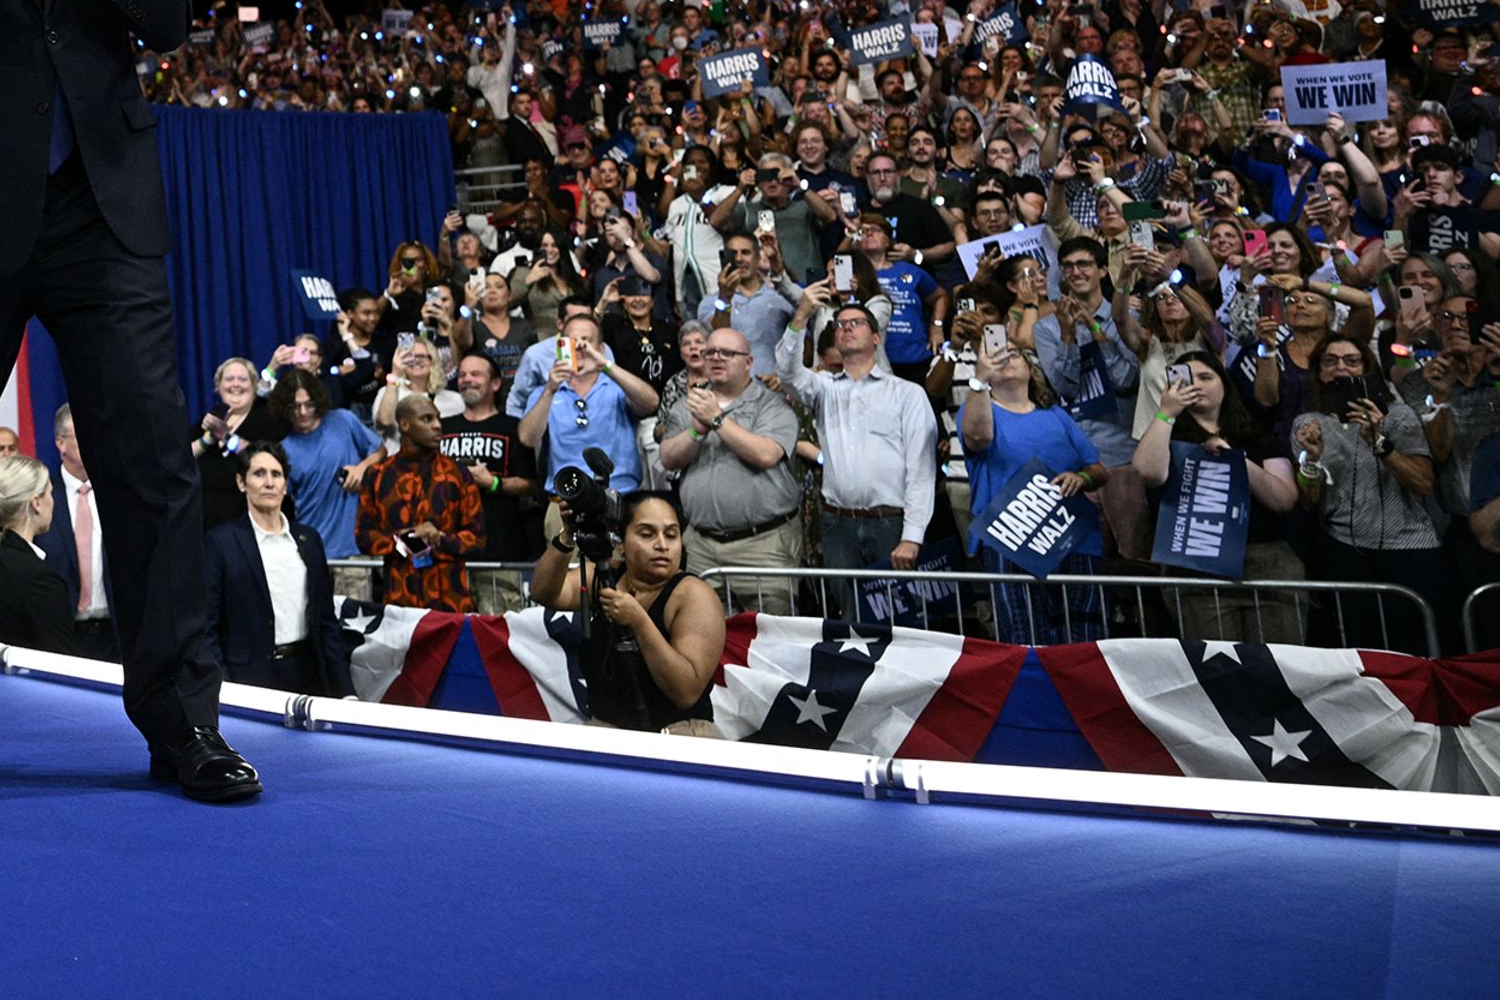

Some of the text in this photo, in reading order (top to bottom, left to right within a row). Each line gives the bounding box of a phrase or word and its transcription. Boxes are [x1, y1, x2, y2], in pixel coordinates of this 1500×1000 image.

[1430, 5, 1479, 21] WALZ
[852, 23, 903, 50] HARRIS
[863, 42, 898, 58] WALZ
[704, 52, 760, 81] HARRIS
[1066, 60, 1117, 91] ARRIS
[1296, 73, 1373, 85] WHEN WE VOTE
[1068, 85, 1113, 102] WALZ
[1295, 82, 1377, 109] WE WIN
[1002, 242, 1016, 252] WE
[440, 437, 502, 460] HARRIS
[986, 473, 1065, 552] HARRIS
[1170, 457, 1197, 553] WHEN WE FIGHT
[1184, 459, 1231, 558] WE WIN
[1026, 505, 1076, 556] WALZ
